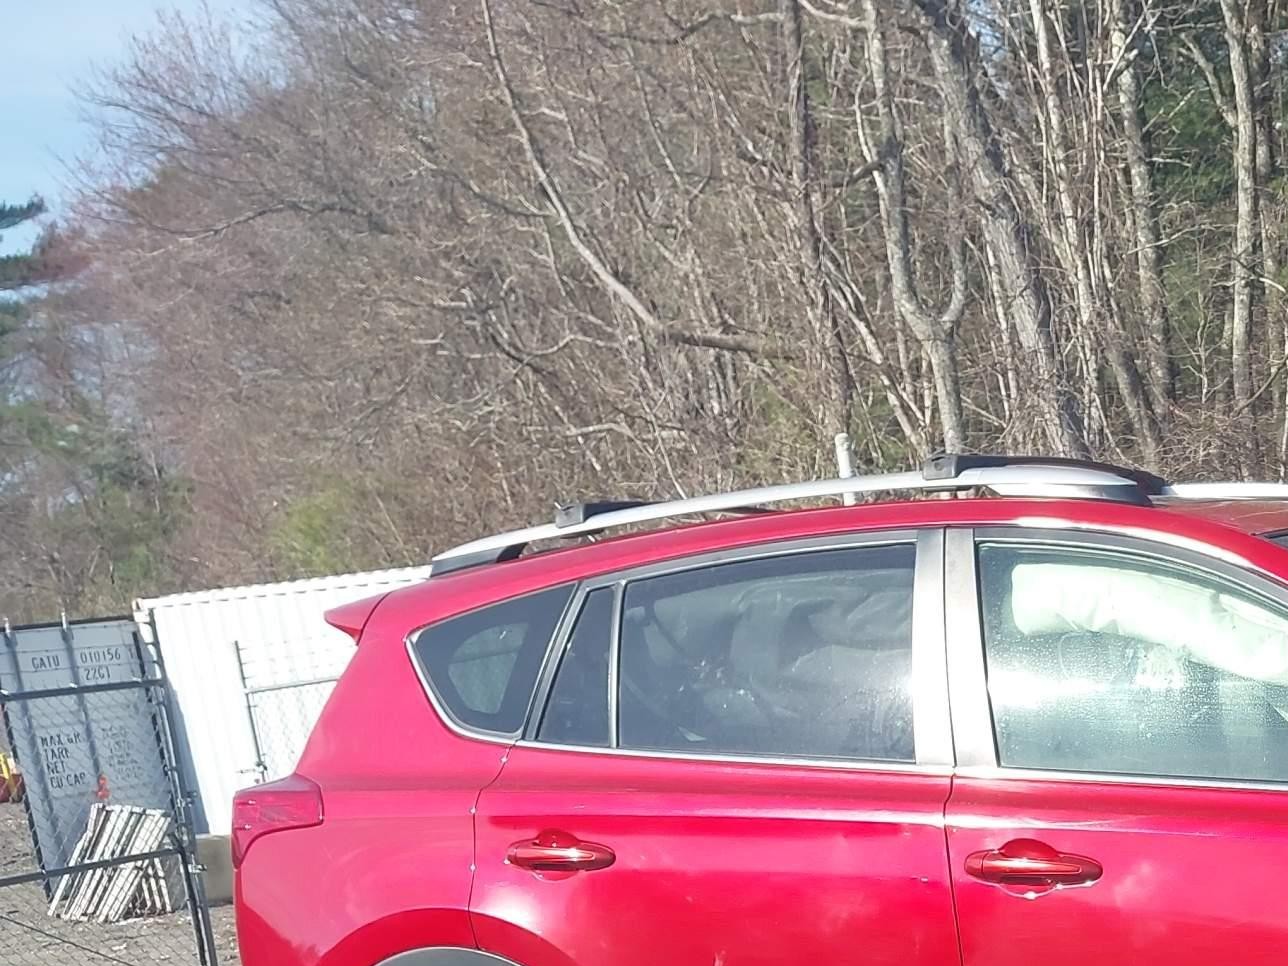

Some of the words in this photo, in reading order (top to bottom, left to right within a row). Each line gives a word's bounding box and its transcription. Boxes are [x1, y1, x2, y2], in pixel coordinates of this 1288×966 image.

[31, 655, 60, 670] GATU
[80, 647, 121, 664] 010156
[41, 734, 64, 748] MAX
[46, 760, 66, 776] NET
